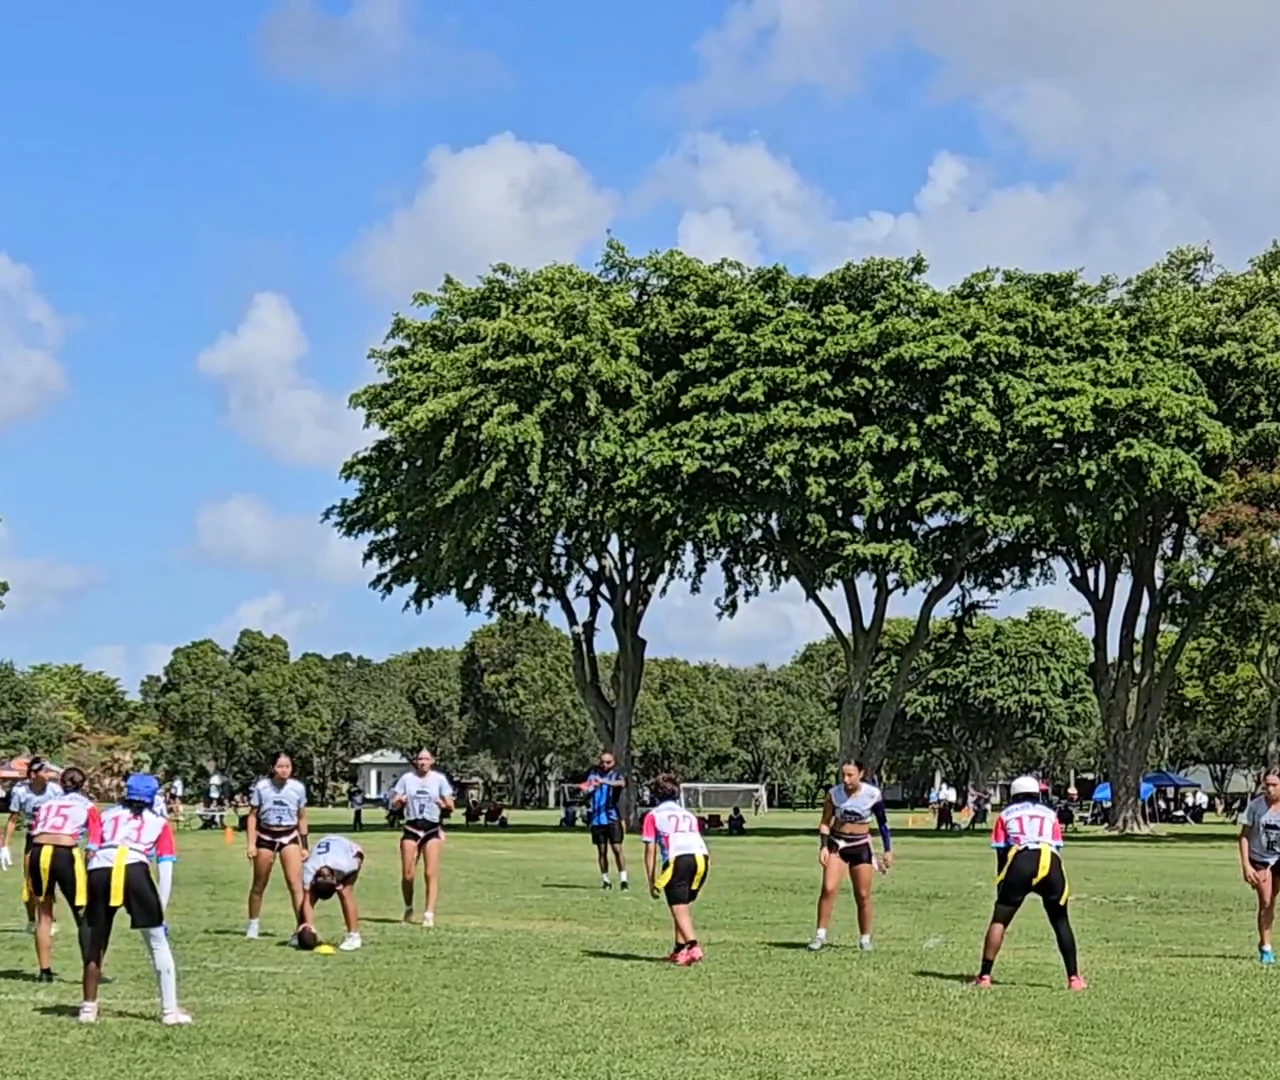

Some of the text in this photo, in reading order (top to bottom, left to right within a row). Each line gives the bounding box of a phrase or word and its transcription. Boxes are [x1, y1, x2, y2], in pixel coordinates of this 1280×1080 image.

[41, 804, 77, 830] 15
[110, 815, 145, 842] 13
[667, 814, 694, 833] 22
[1013, 815, 1046, 837] 17
